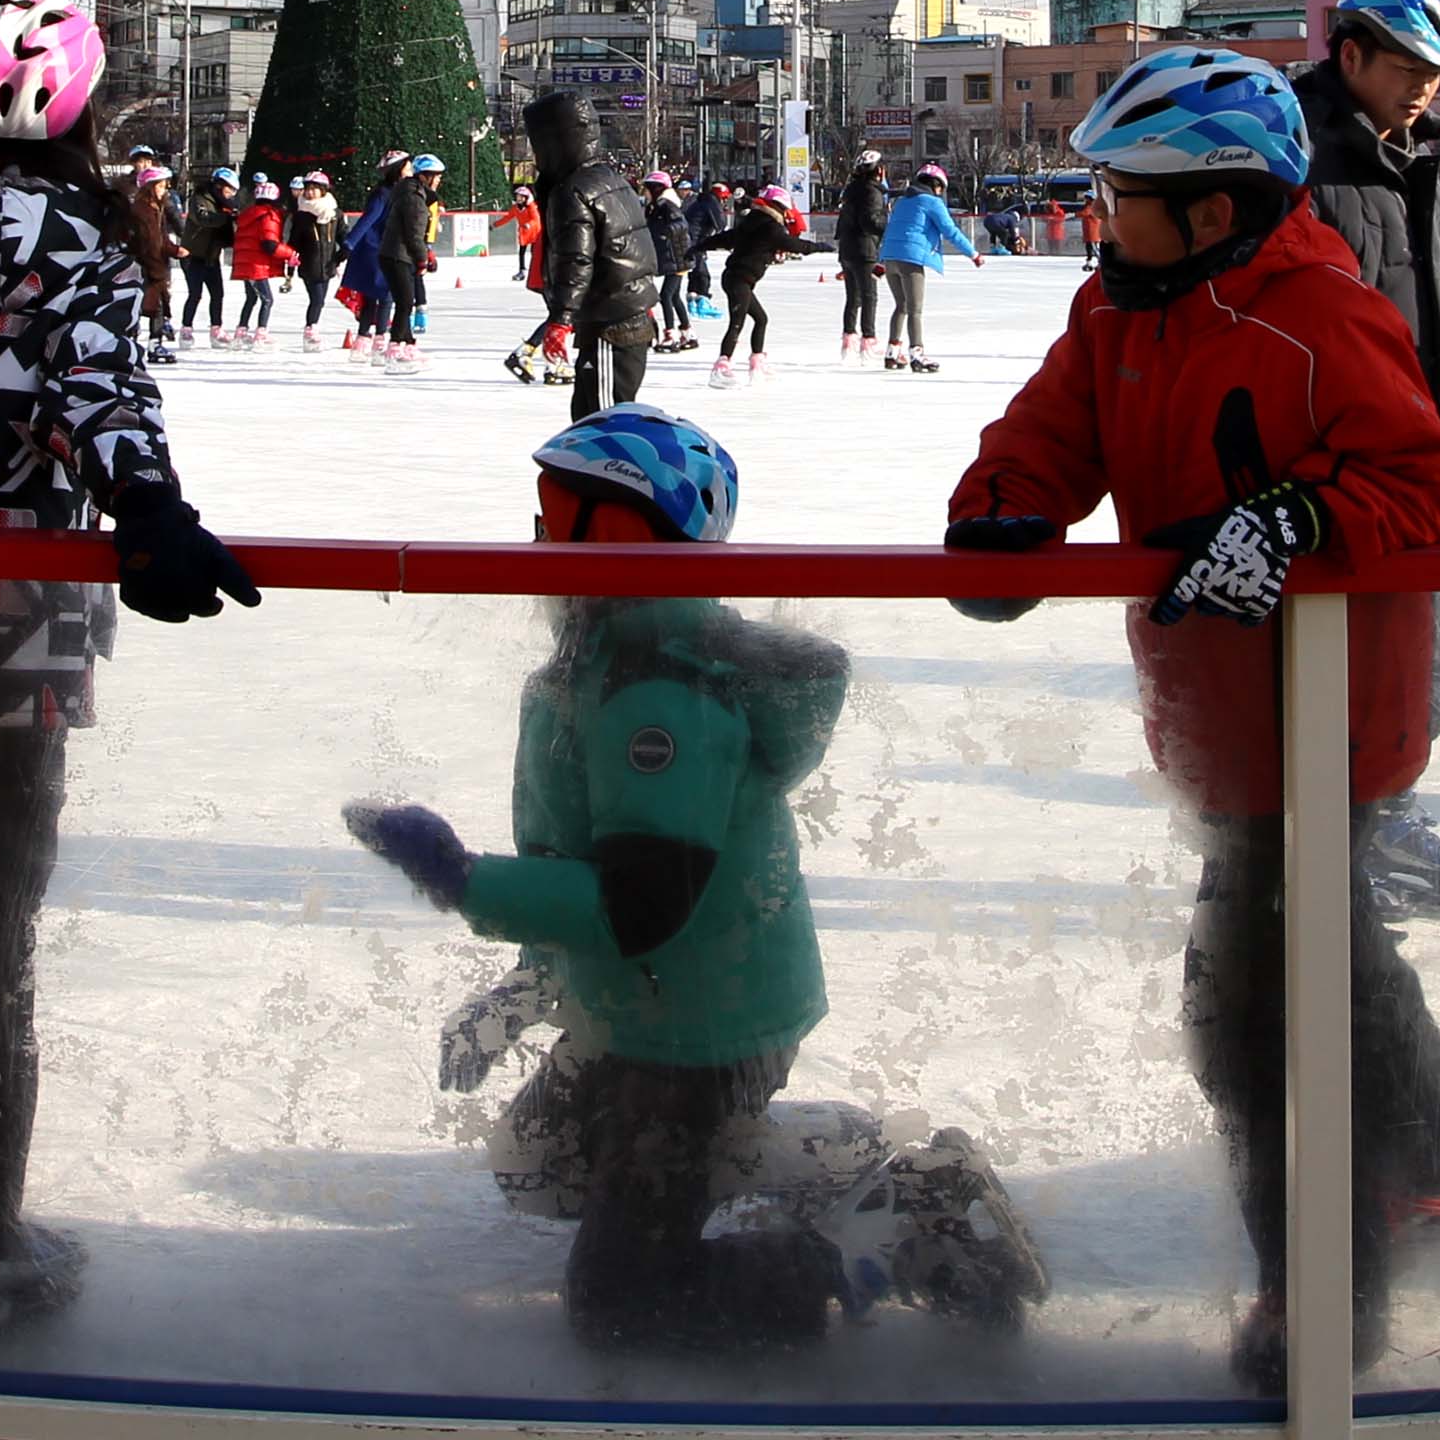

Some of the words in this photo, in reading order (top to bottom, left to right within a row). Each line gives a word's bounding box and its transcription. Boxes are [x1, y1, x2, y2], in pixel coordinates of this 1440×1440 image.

[579, 68, 635, 83] 전당포
[1205, 149, 1254, 166] Champ
[603, 460, 648, 483] Champ
